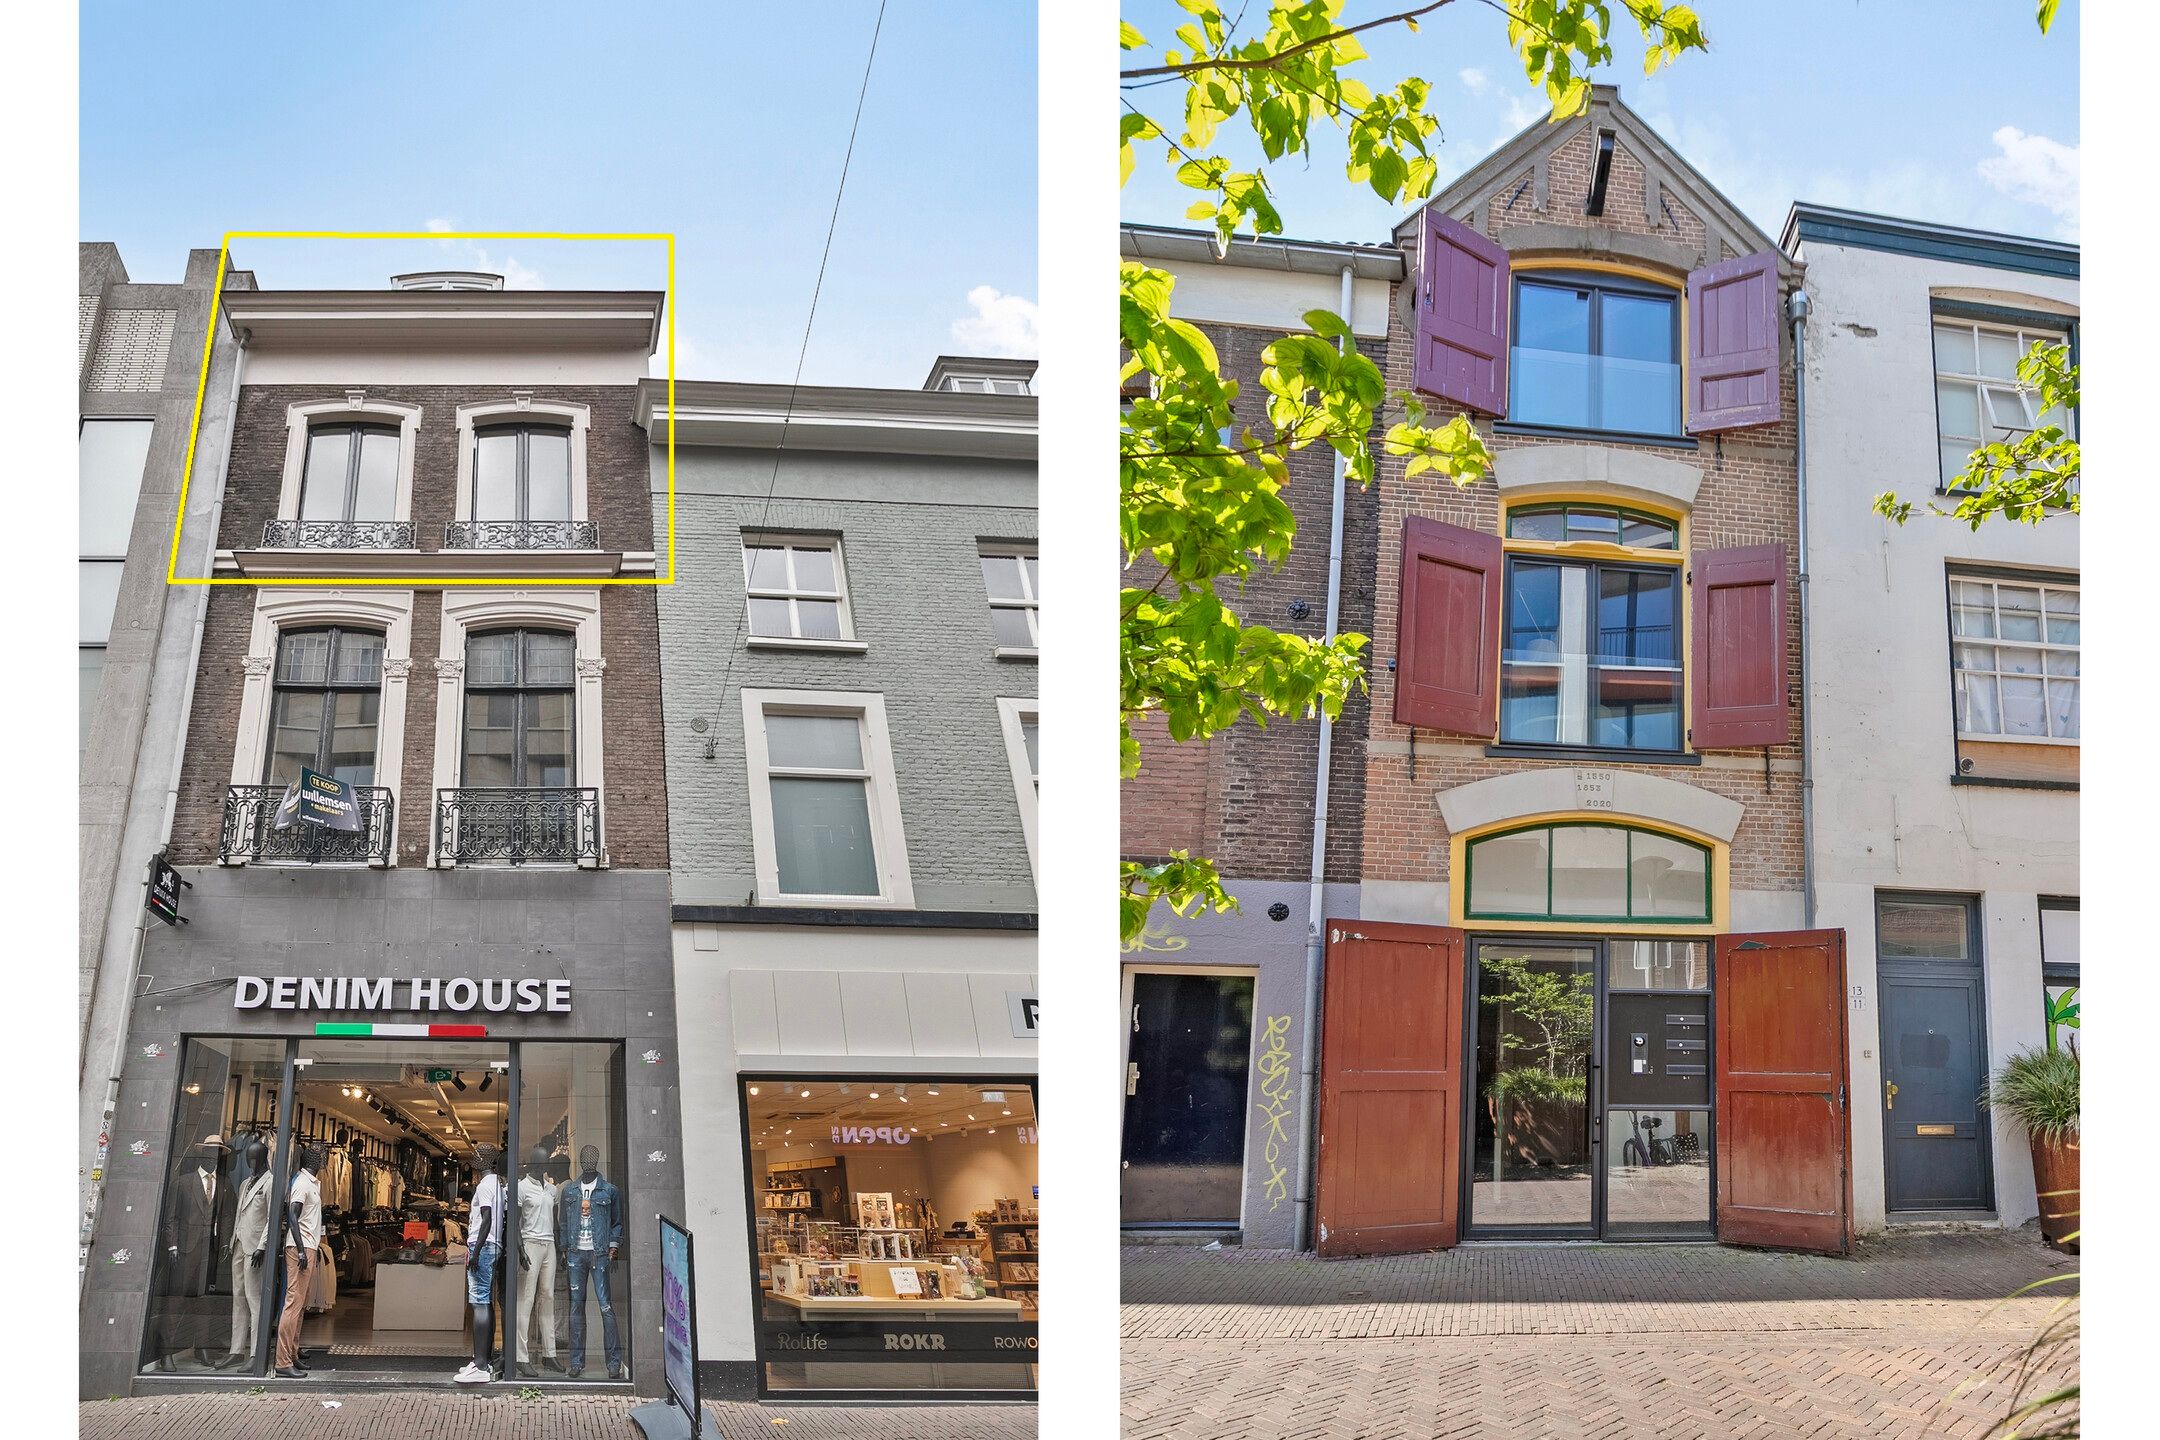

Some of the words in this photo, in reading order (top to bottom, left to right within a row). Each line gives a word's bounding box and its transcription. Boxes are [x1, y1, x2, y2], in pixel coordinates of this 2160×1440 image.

[312, 777, 320, 787] TE
[320, 780, 339, 792] KOOP
[302, 789, 353, 812] willemsen
[233, 976, 393, 1010] DENIM
[410, 977, 572, 1012] HOUSE
[1852, 986, 1862, 995] 13
[1853, 999, 1862, 1009] 11
[777, 1332, 828, 1351] Rolife
[883, 1333, 947, 1351] ROKR
